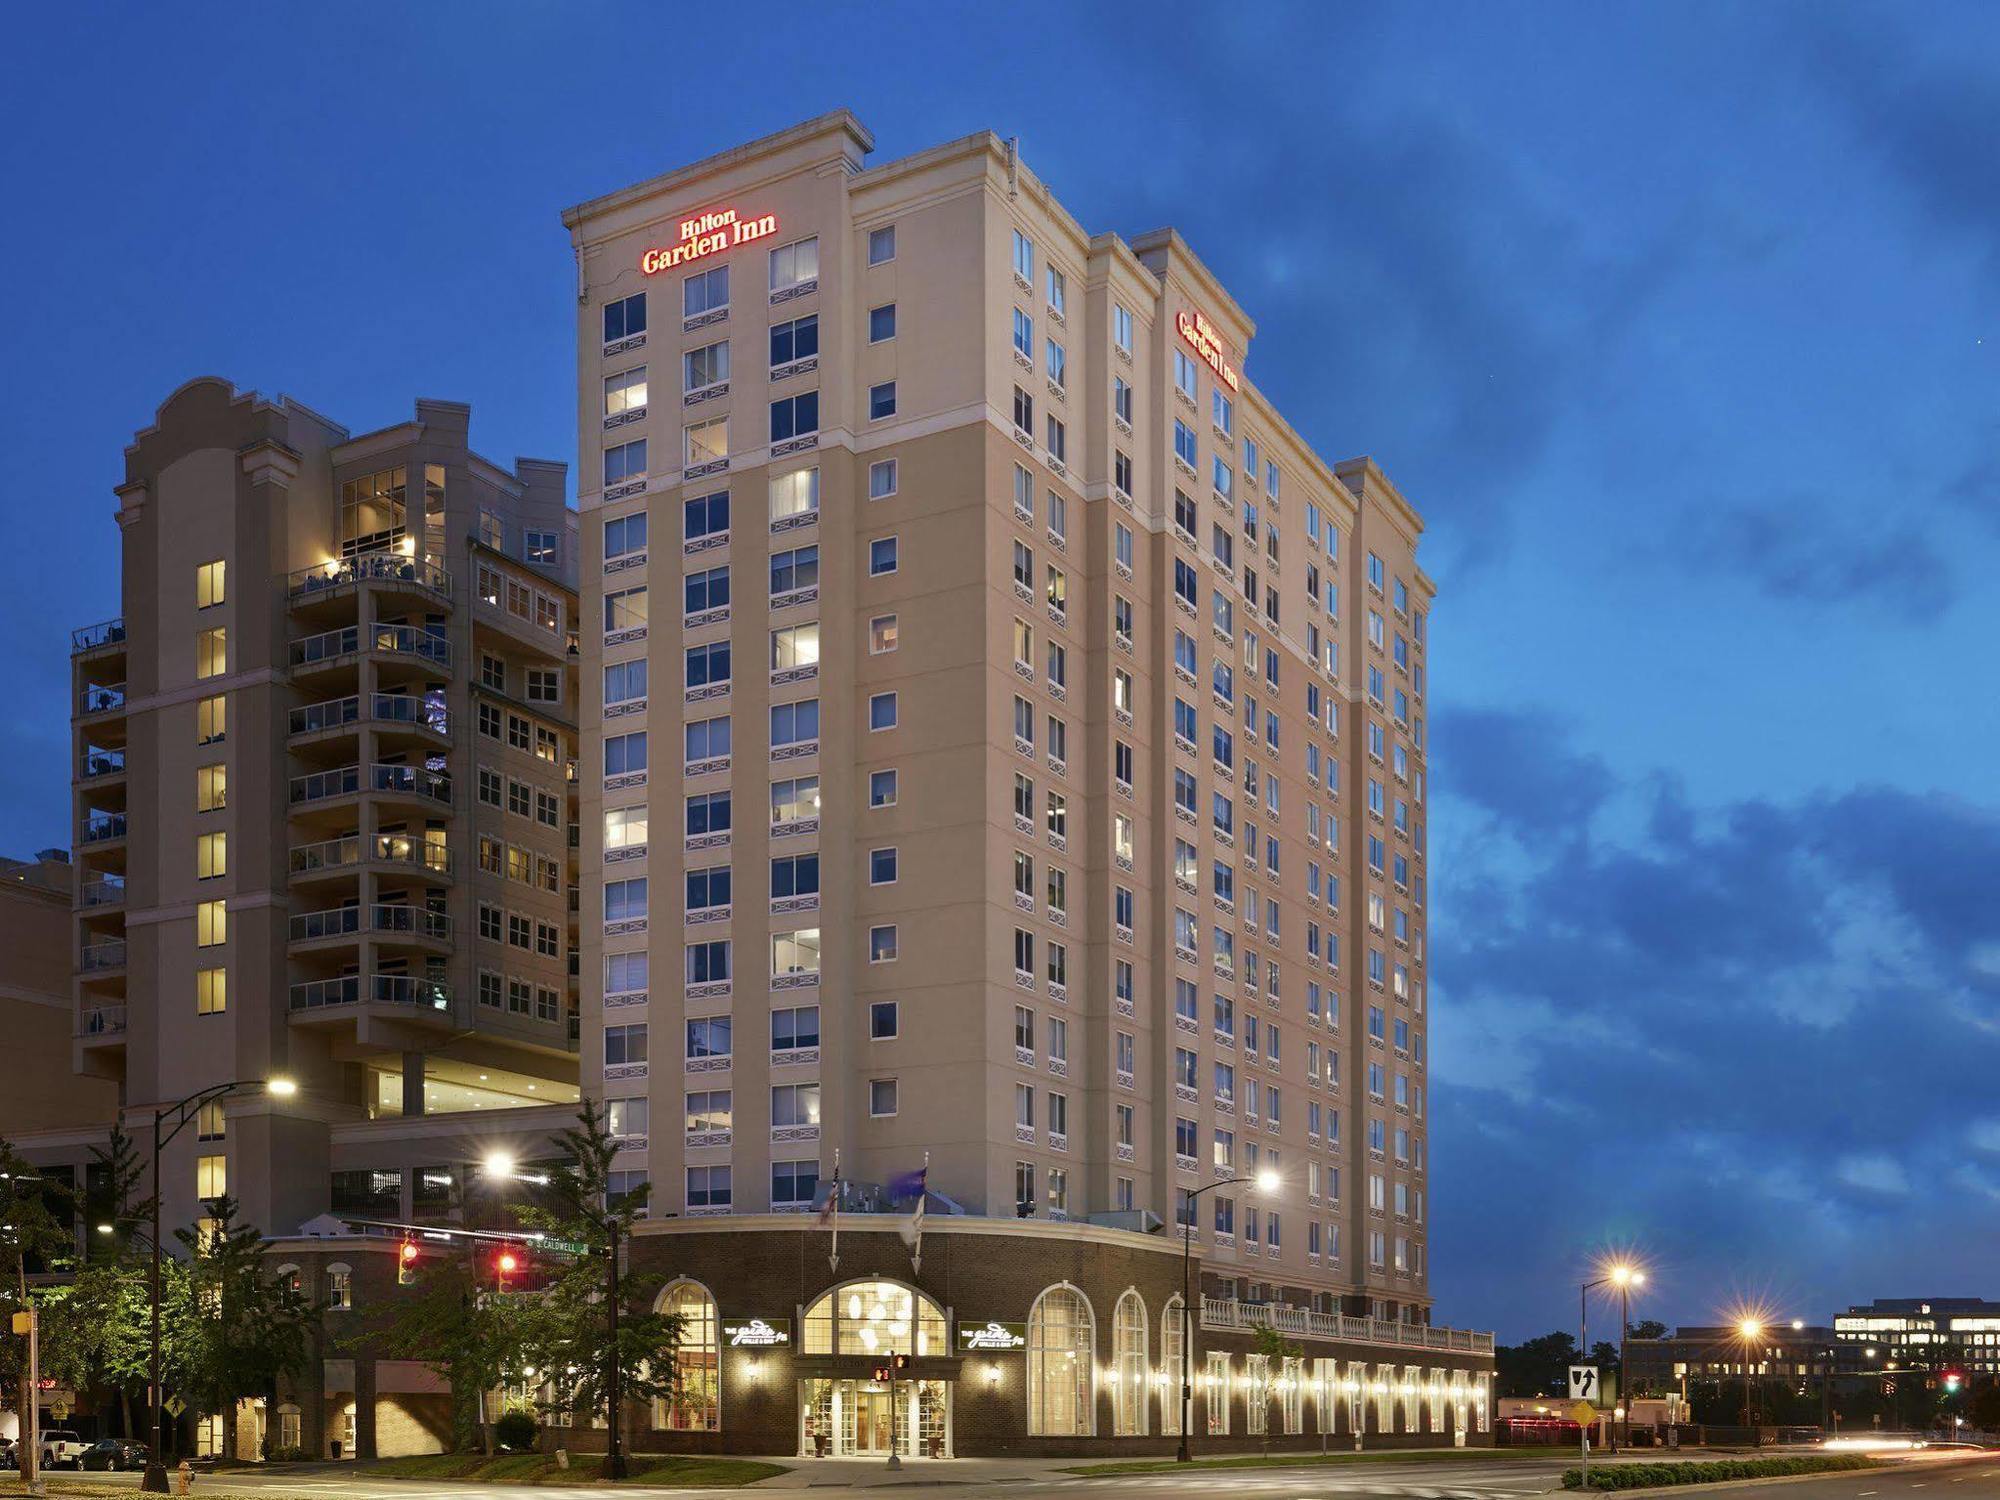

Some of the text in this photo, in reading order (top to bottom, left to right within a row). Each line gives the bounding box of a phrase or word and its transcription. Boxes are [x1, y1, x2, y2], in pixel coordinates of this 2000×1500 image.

[642, 214, 777, 275] Garden Inn
[680, 209, 737, 240] Hilton
[1178, 312, 1239, 392] Garden Inn
[543, 1240, 576, 1253] CALDWELL
